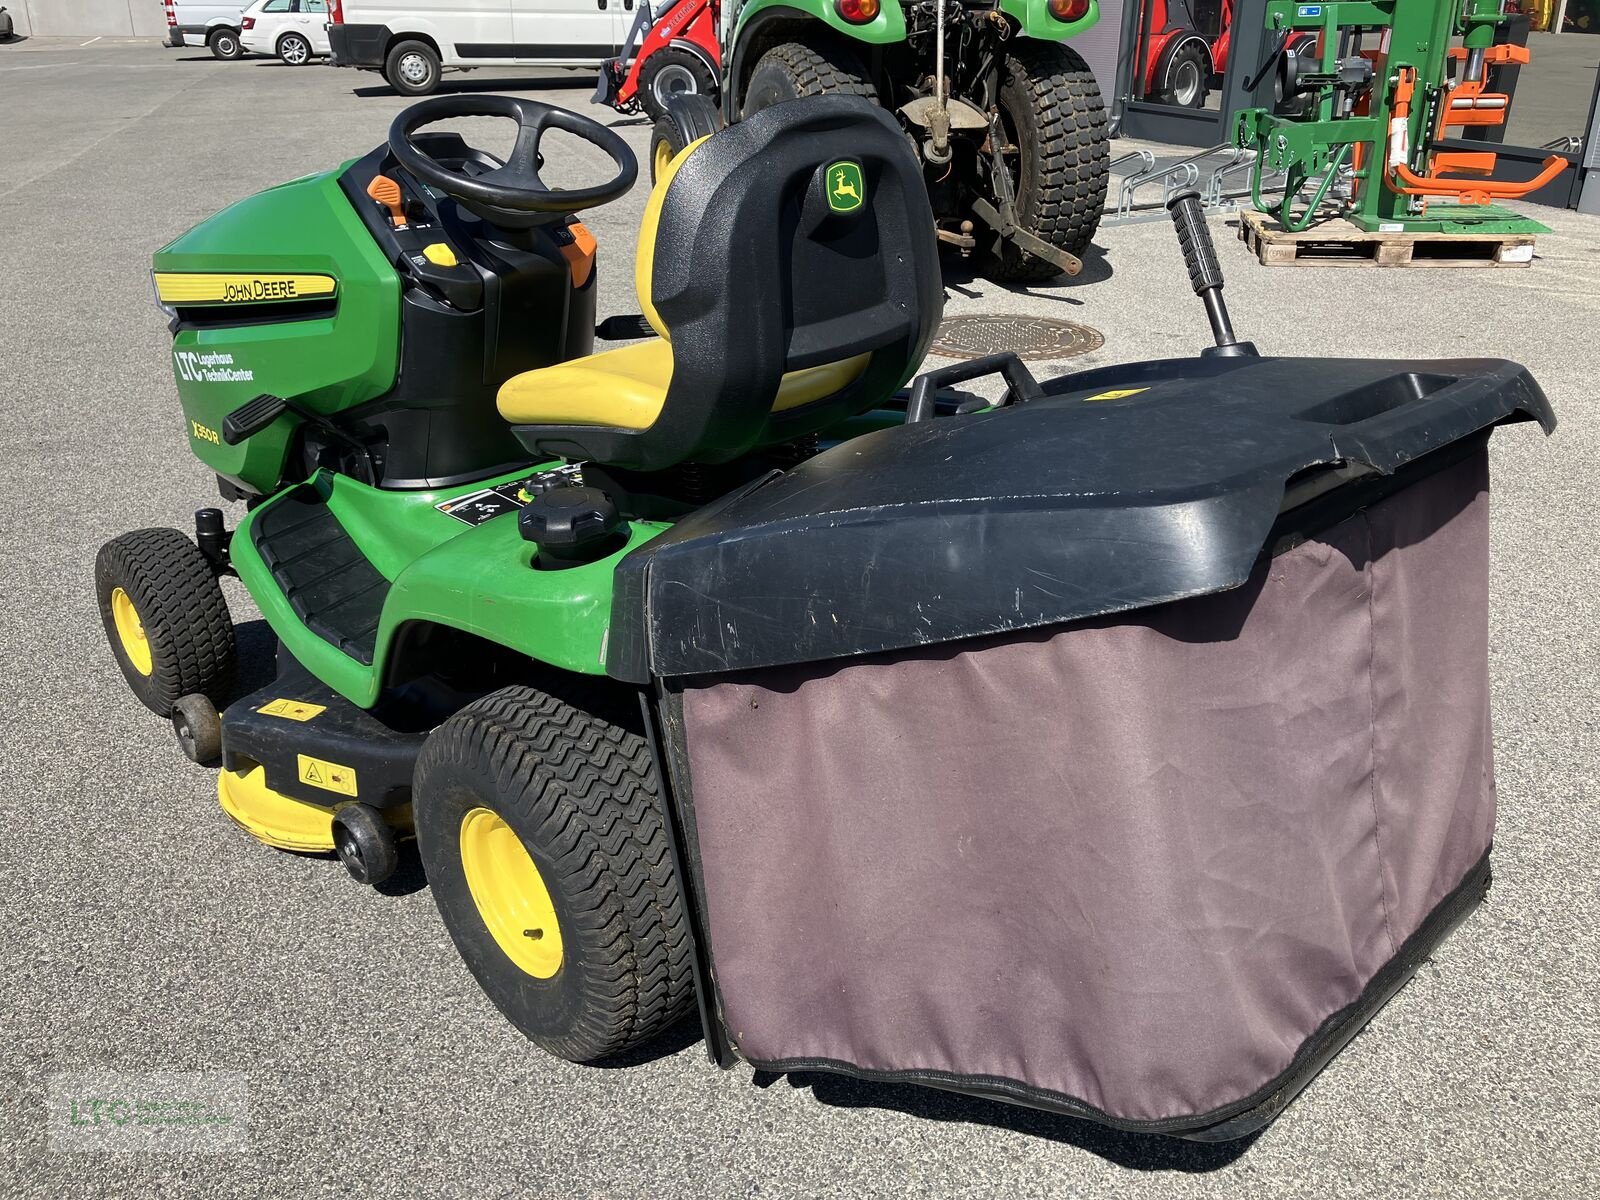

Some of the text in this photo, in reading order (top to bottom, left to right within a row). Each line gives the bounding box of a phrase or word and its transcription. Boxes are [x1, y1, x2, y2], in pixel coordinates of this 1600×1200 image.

[223, 280, 296, 299] JOHN DEERE
[174, 352, 202, 381] LTC
[196, 351, 234, 368] Lagerhaus
[202, 368, 254, 381] TechnikCenter
[191, 419, 220, 445] X350R
